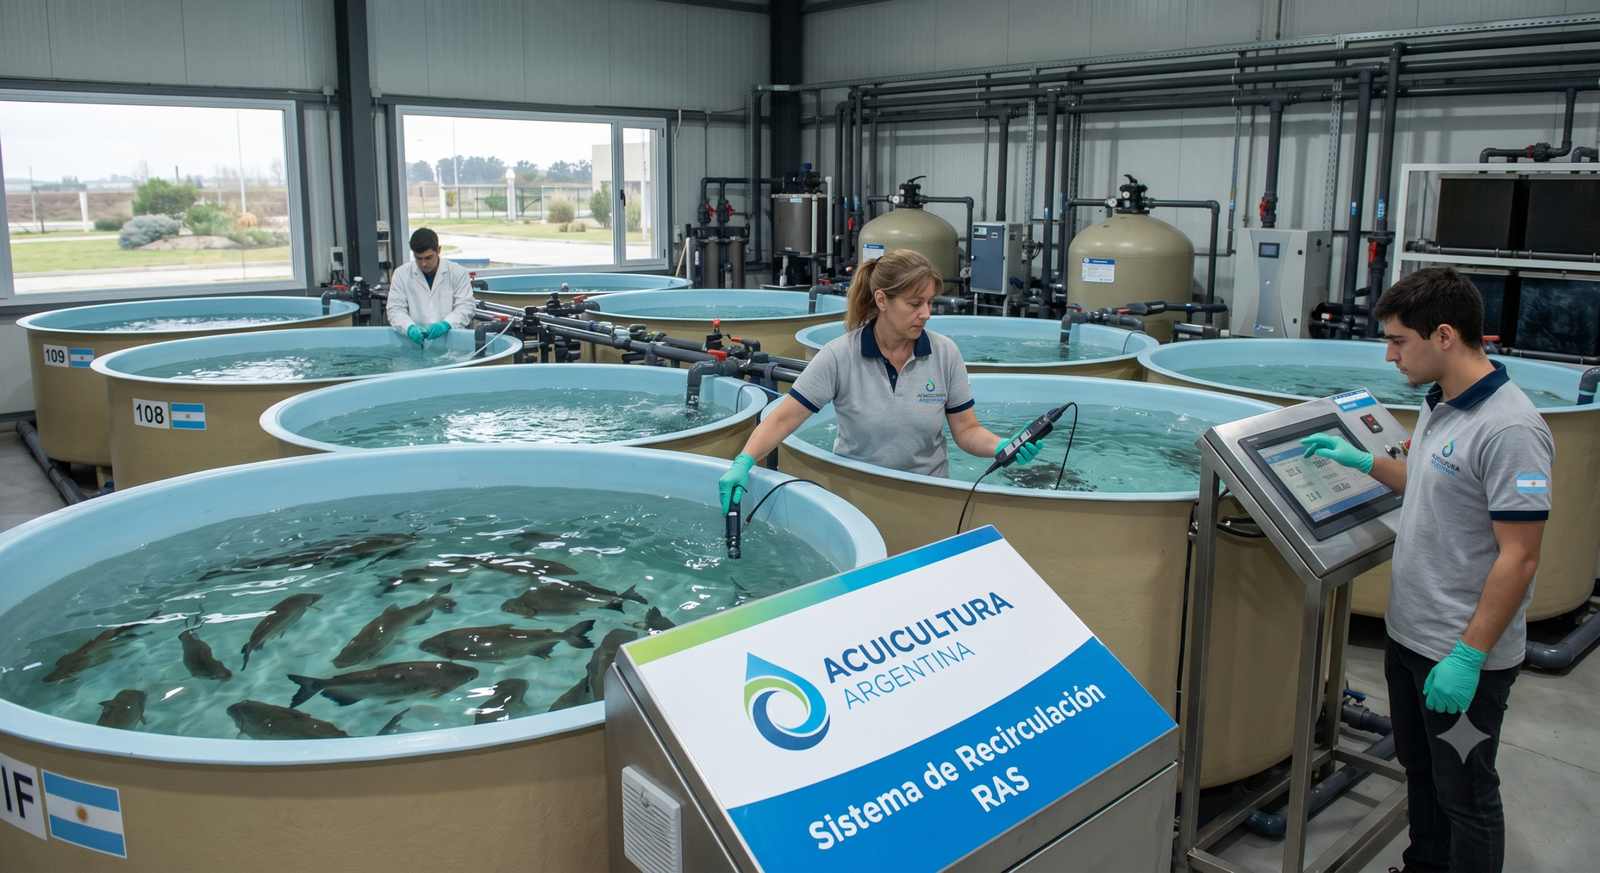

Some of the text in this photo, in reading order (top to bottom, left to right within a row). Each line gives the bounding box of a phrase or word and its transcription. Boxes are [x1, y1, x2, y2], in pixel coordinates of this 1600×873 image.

[45, 349, 65, 364] 109
[136, 403, 164, 425] 108
[823, 591, 1015, 684] ACUICULTURA
[843, 641, 976, 710] ARGENTINA
[808, 683, 1106, 850] Sistema de Recirculación
[970, 766, 1030, 813] RAS
